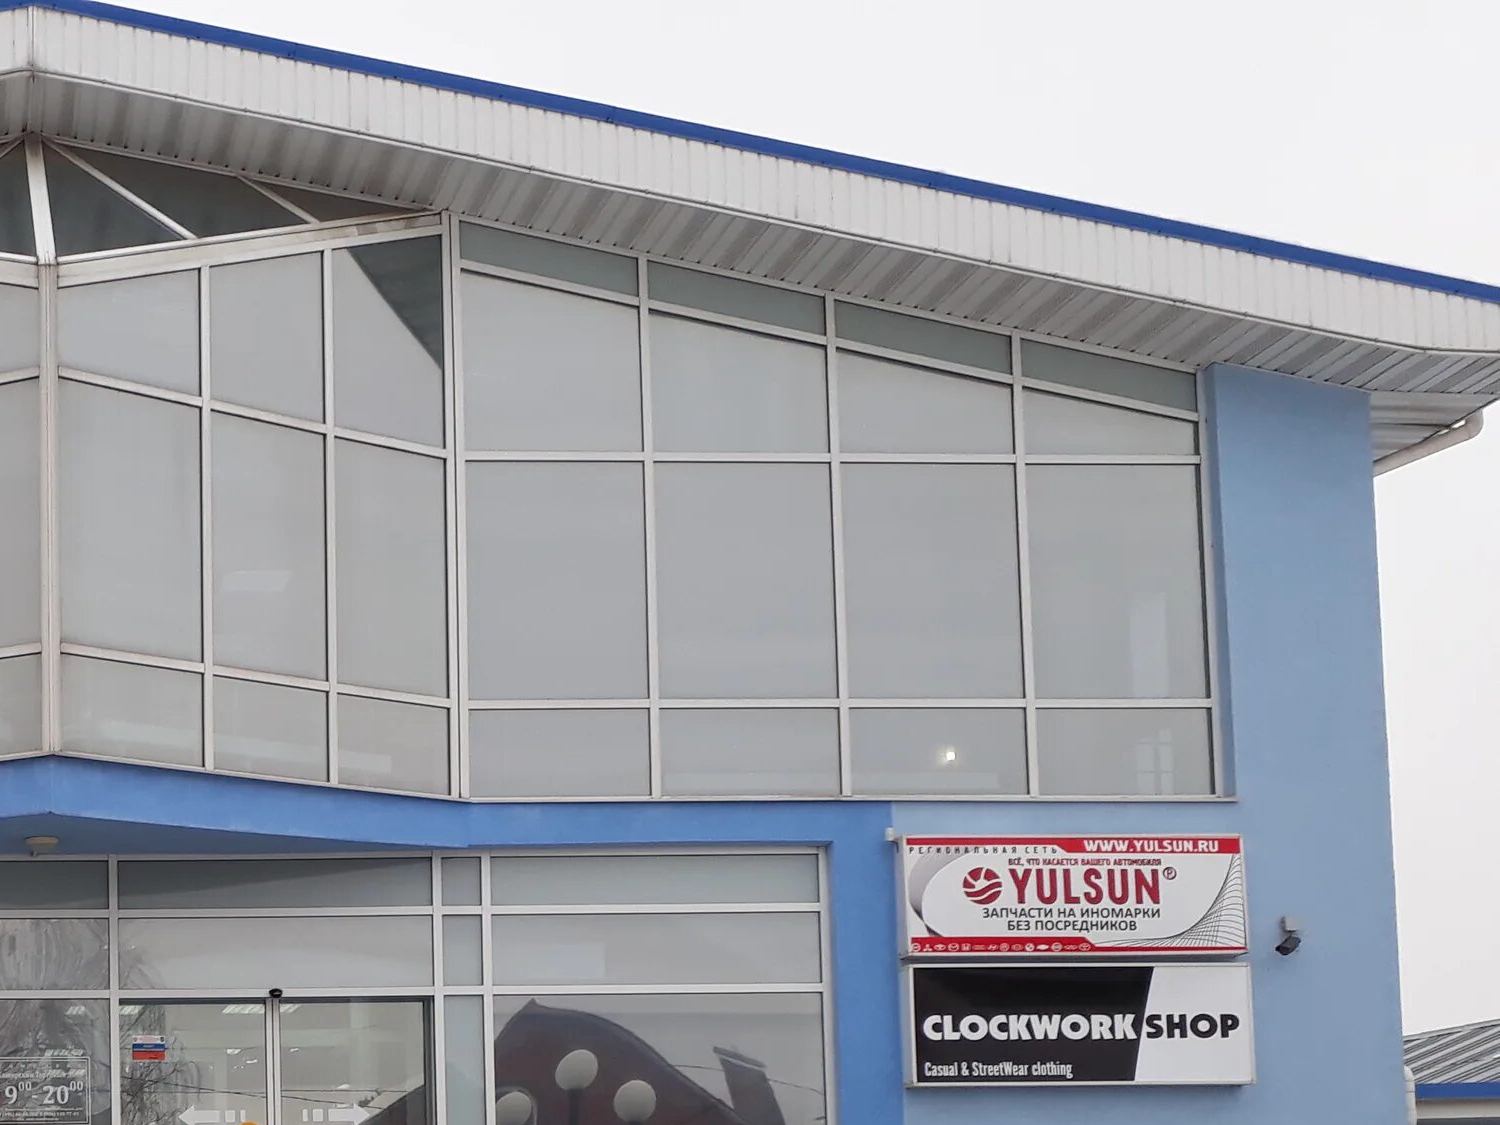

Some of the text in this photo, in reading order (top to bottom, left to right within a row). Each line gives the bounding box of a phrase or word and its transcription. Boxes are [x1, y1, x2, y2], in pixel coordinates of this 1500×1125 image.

[908, 846, 1057, 854] РЕГИОНАЛЬНАЯ СЕТЬ
[1083, 839, 1219, 853] WWW.YULSUN.RU
[982, 907, 1161, 919] ЗАПЧАСТИ НА ИНОМАРКИ
[1007, 919, 1138, 932] БЕЗ ПОСРЕДНИКОВ
[923, 1013, 1240, 1041] CLOCKWORK SHOP
[924, 1061, 1074, 1079] Casual & StreetWear clothing
